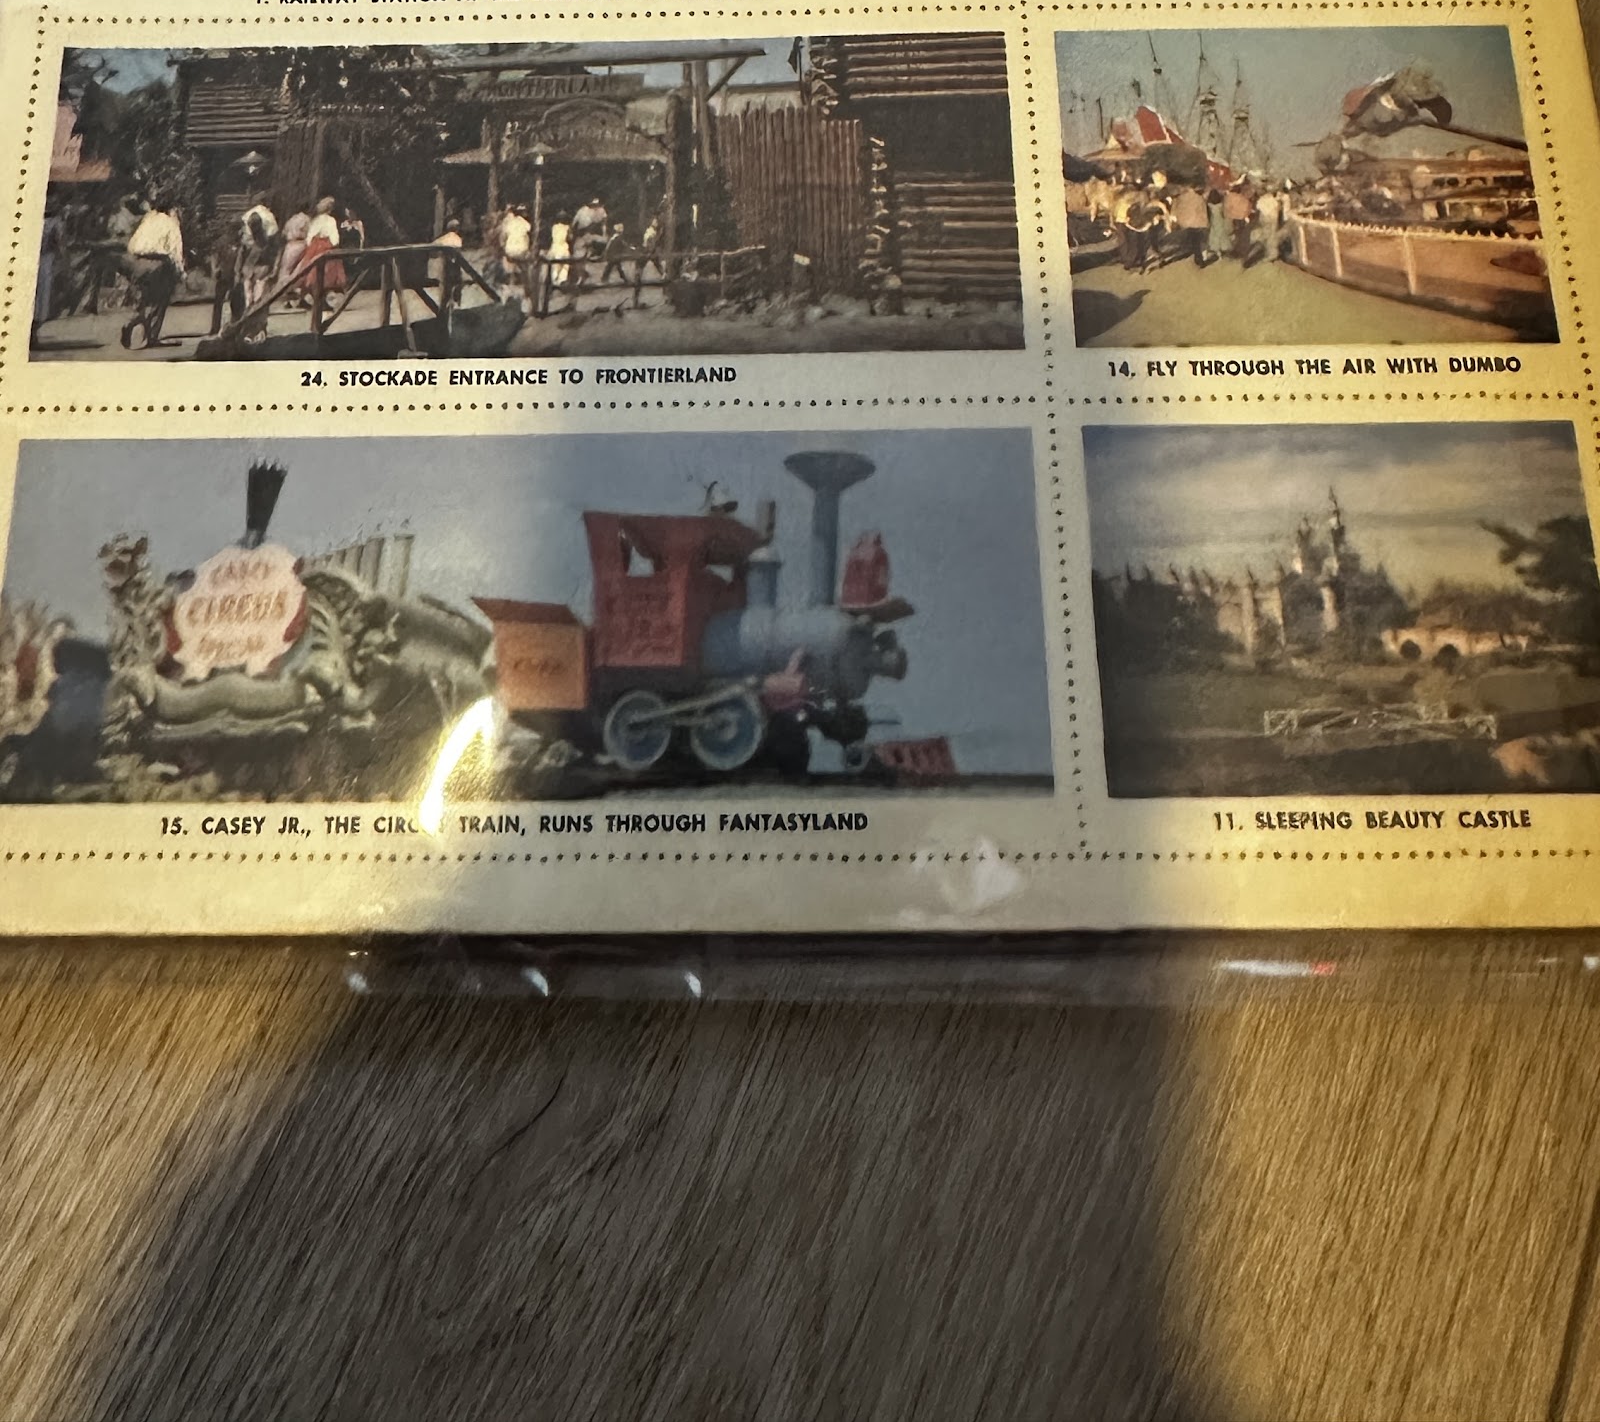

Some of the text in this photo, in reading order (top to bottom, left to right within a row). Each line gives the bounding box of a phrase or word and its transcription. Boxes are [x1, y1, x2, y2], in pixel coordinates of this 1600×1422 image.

[301, 367, 737, 387] 24. STOCKADE ENTRANCE TO FRONTIERLAND
[1108, 356, 1521, 377] 14. FLY THROUGH THE AIR WITH DUMBO
[161, 812, 868, 837] 15. CASEY JR., THE CIRC TRAIN, RUNS THROUGH FANTASYLAND
[1214, 809, 1532, 830] 11. SLEEPING BEAUTY CASTLE
